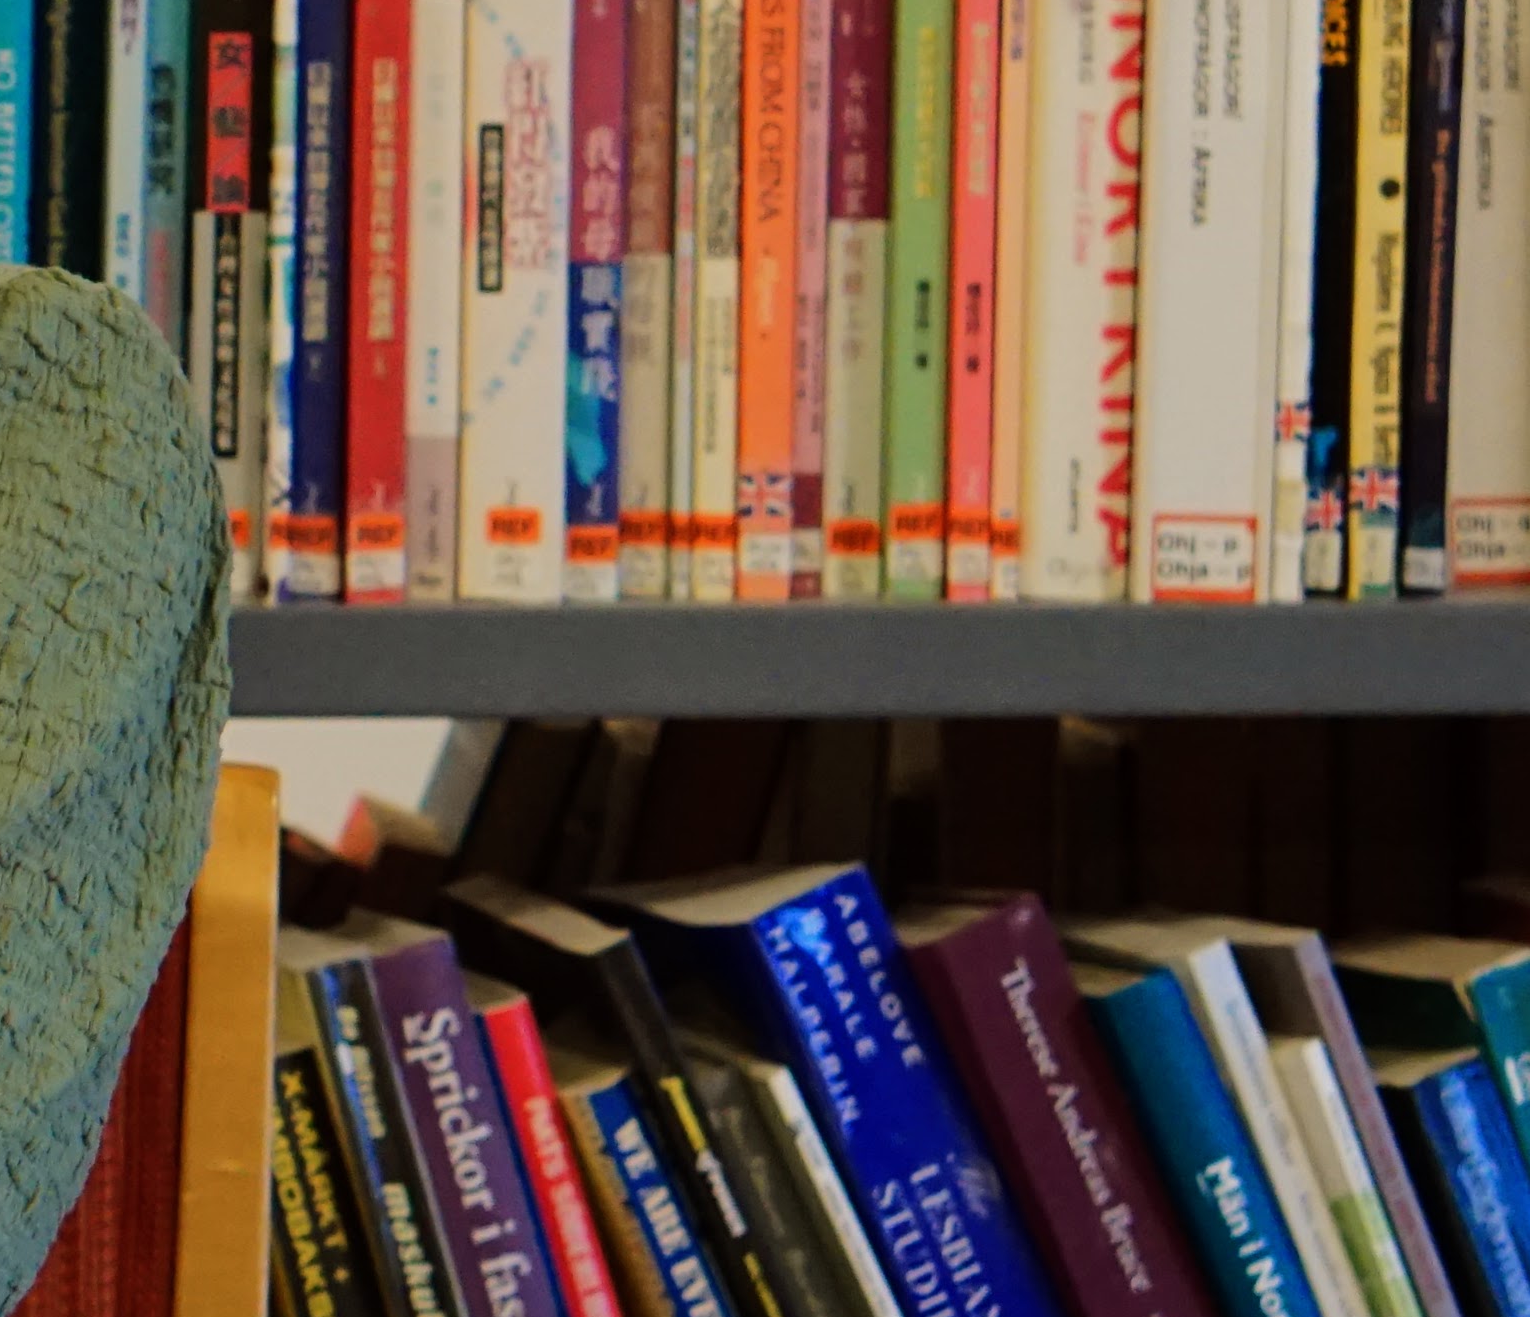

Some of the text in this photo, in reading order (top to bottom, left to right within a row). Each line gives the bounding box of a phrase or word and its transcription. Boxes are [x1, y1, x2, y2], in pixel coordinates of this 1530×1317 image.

[757, 25, 786, 114] FROM
[756, 120, 785, 222] CHINA
[1190, 146, 1213, 227] AFRIKA
[1473, 113, 1495, 210] AMERIKA
[762, 921, 865, 1129] HALPERIN
[795, 903, 883, 1066] BARALE
[831, 885, 928, 1073] ABELOVE
[397, 1004, 503, 1219] Sprickor
[470, 1220, 510, 1244] i
[608, 1116, 658, 1180] WE
[635, 1179, 693, 1259] ARE
[1199, 1153, 1263, 1241] Män
